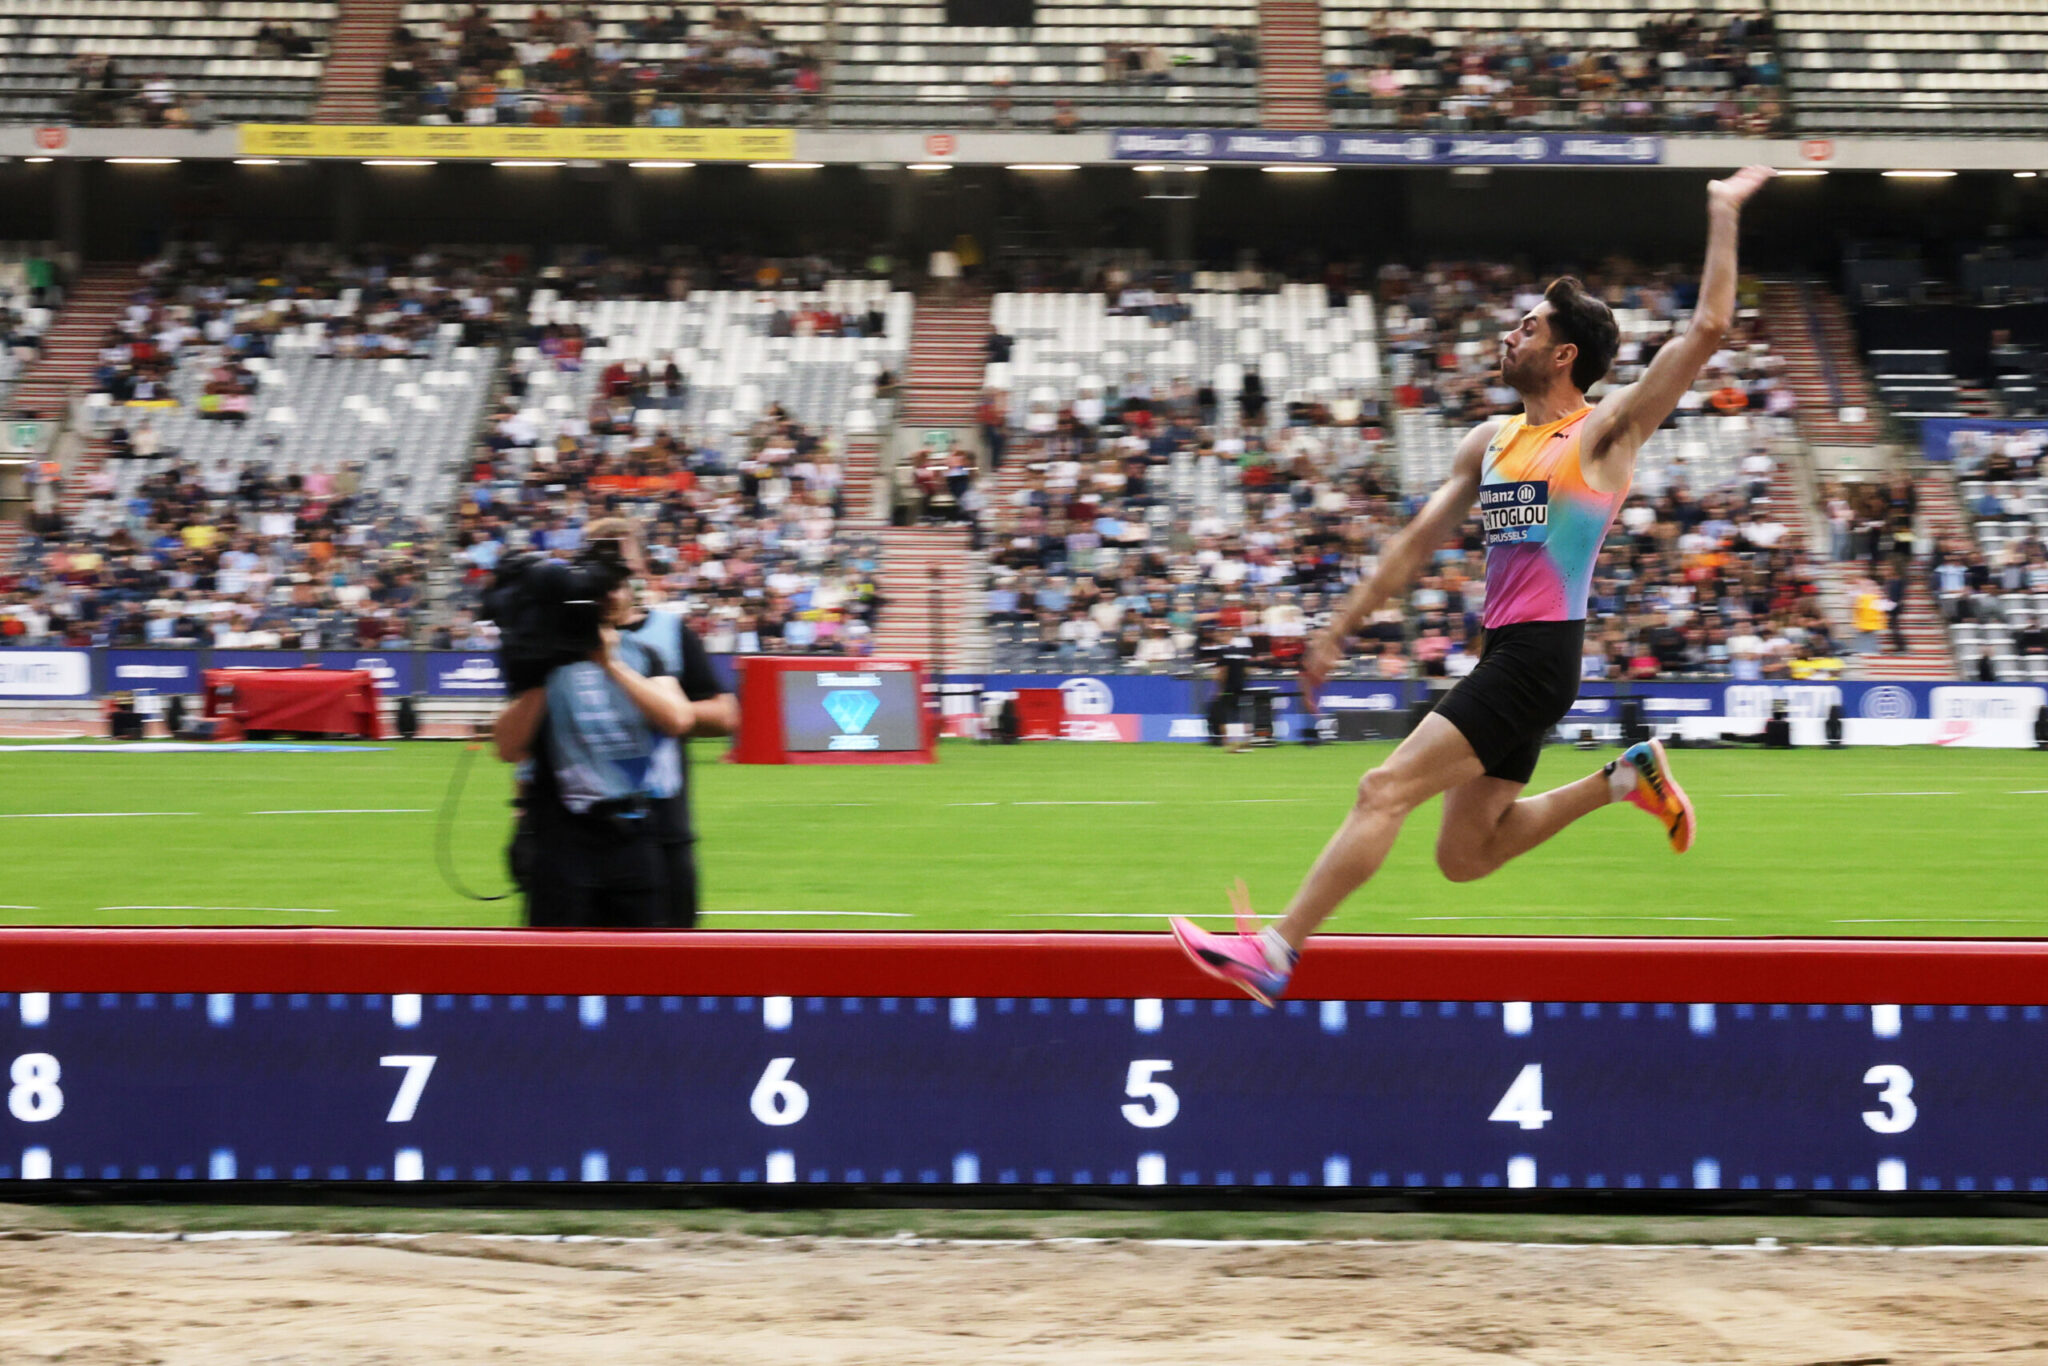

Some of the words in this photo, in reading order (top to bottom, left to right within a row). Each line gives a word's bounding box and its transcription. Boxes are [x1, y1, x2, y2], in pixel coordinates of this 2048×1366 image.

[1480, 490, 1514, 504] Allianz
[1490, 530, 1527, 544] BRUSSELS
[8, 1053, 63, 1123] 8
[379, 1055, 438, 1123] 7
[749, 1057, 810, 1126] 6
[1120, 1059, 1180, 1129] 5
[1487, 1063, 1553, 1131] 4
[1861, 1064, 1917, 1134] 3
